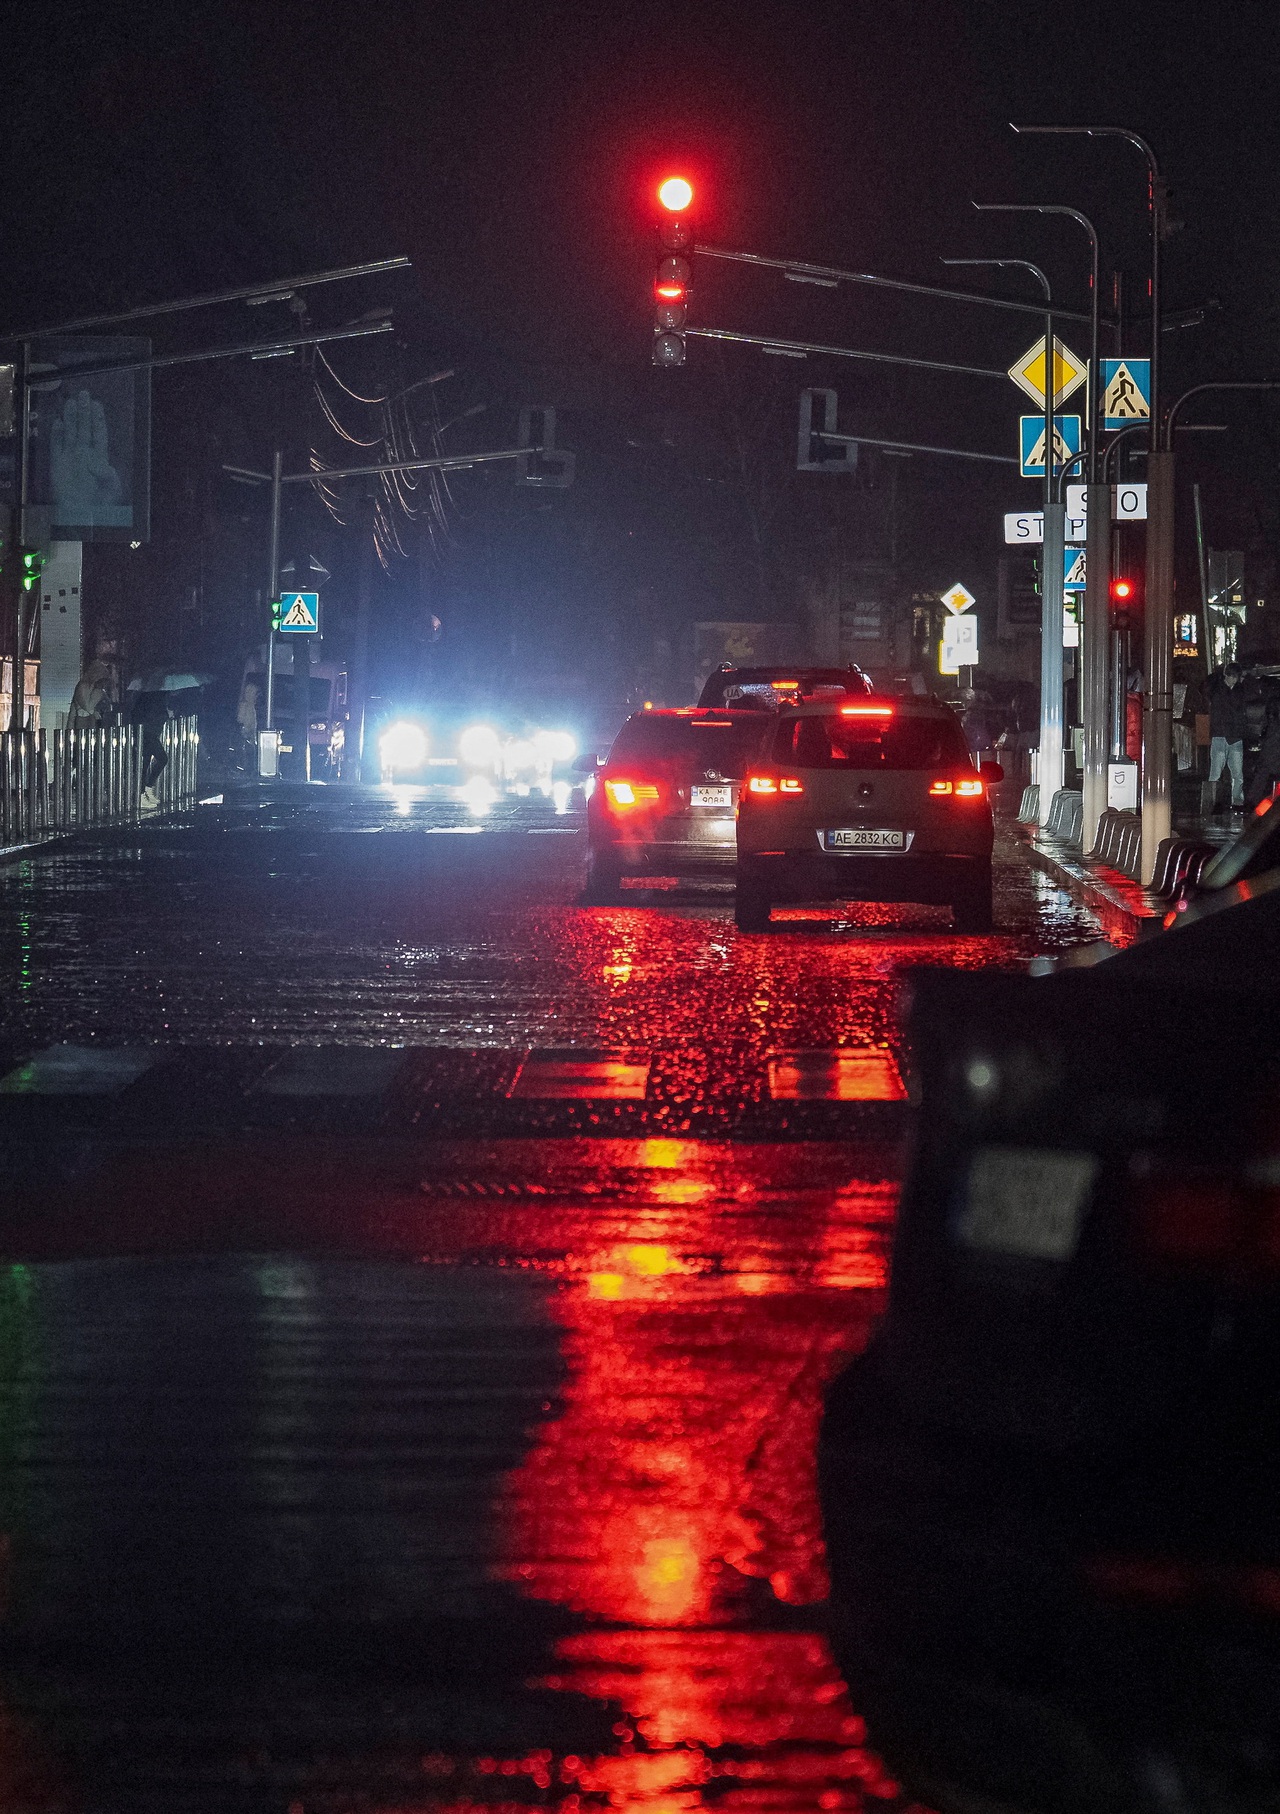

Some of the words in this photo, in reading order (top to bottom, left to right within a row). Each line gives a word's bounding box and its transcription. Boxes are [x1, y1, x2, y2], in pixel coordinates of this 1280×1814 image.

[1016, 518, 1084, 538] STP
[835, 832, 851, 844] AE
[854, 832, 880, 844] 2832
[882, 833, 899, 844] KC
